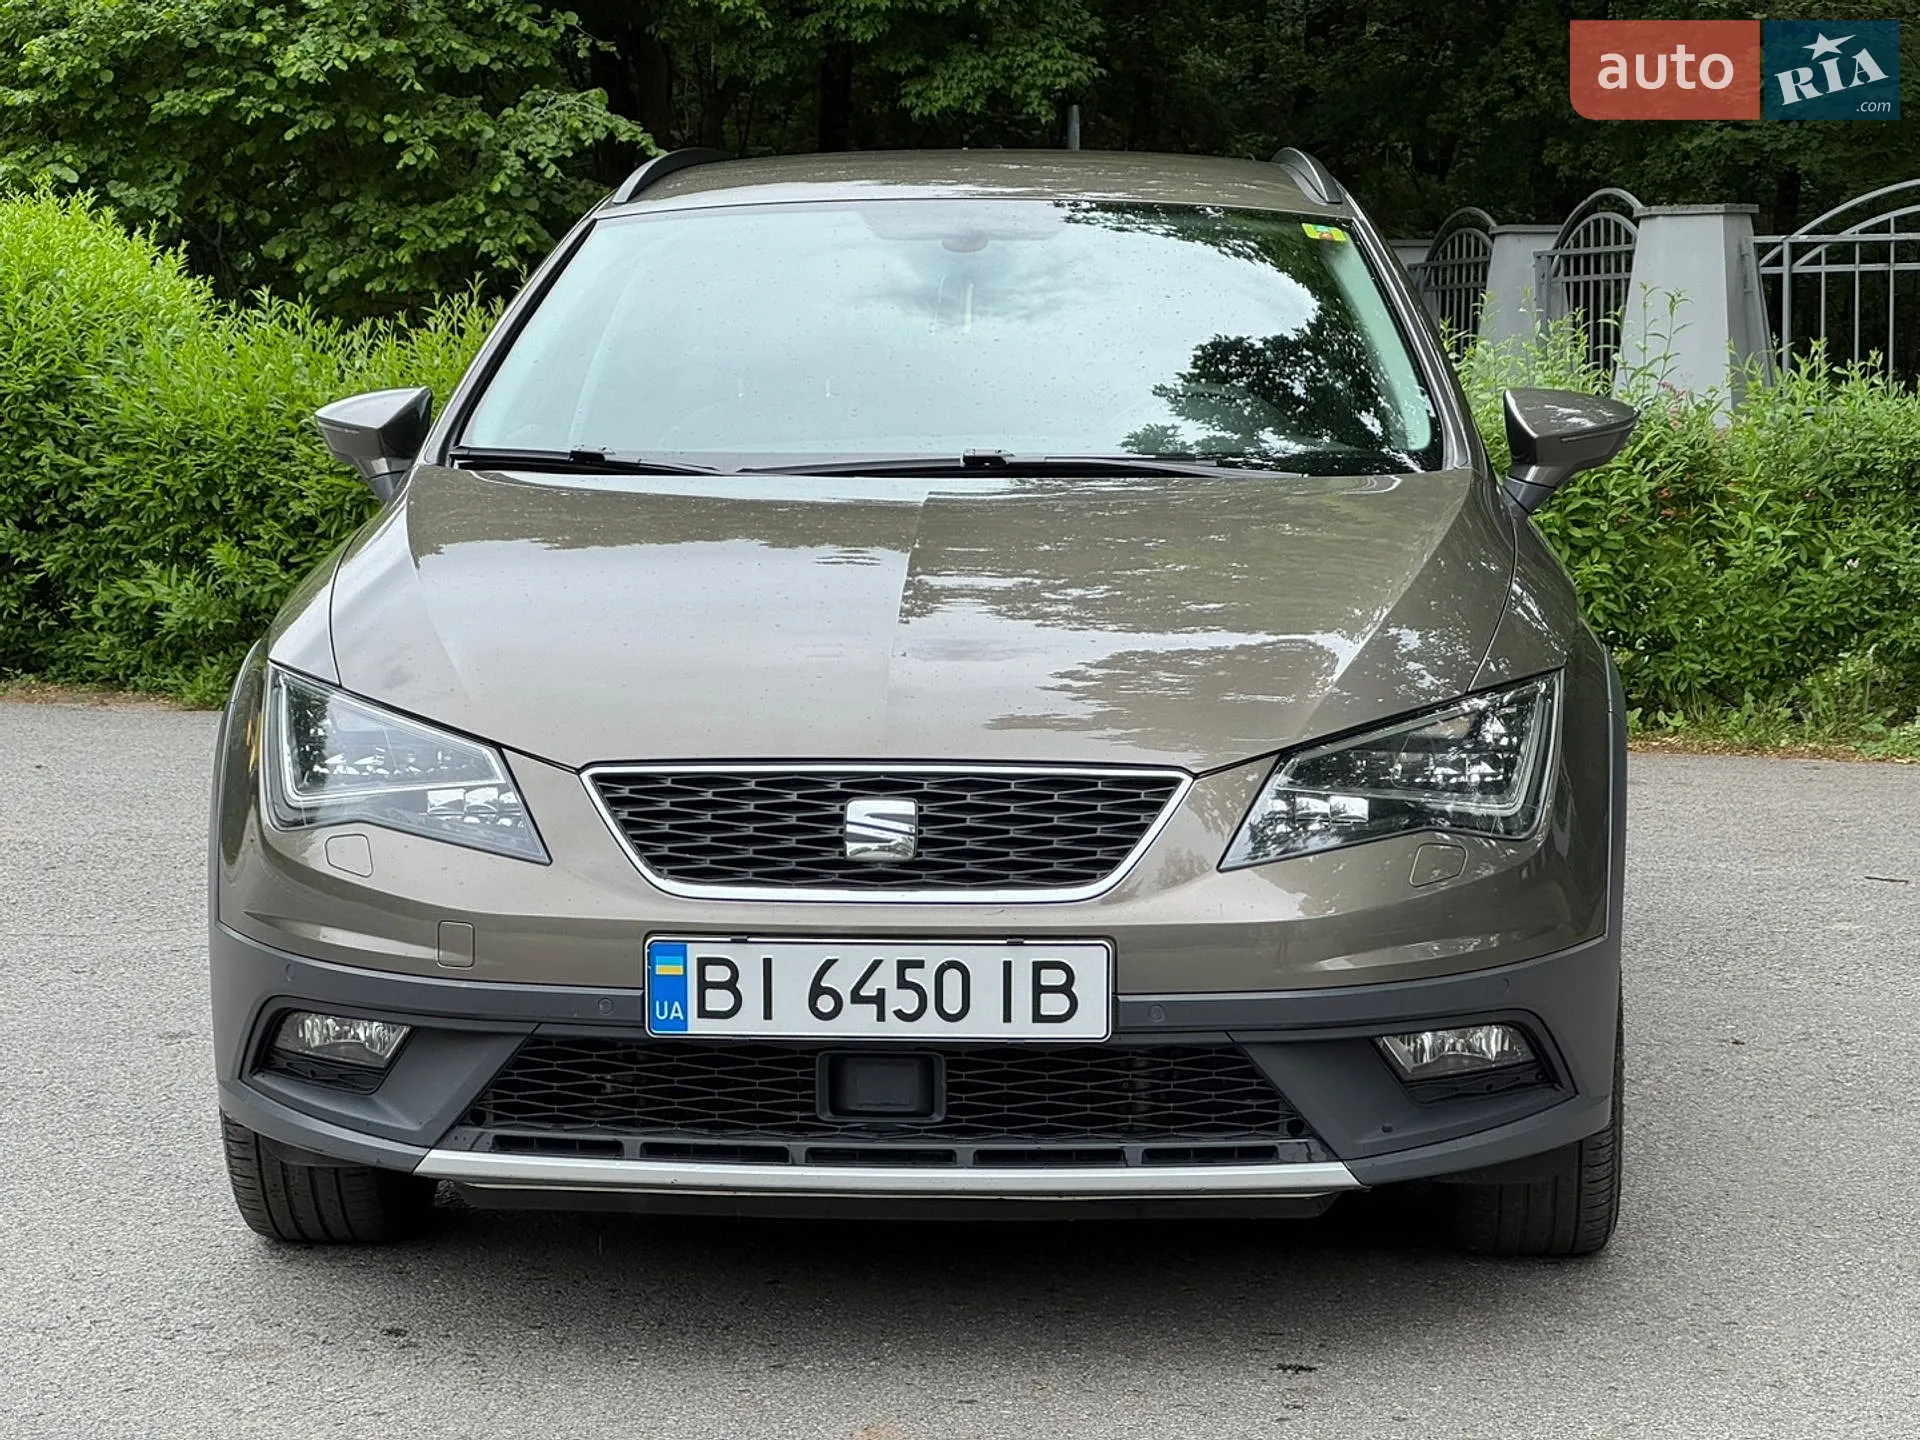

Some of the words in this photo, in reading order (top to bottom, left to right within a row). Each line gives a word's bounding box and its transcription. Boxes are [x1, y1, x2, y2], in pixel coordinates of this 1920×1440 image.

[654, 1000, 685, 1021] UA
[695, 956, 773, 1021] BI
[807, 957, 972, 1024] 6450
[1002, 958, 1079, 1025] IB
